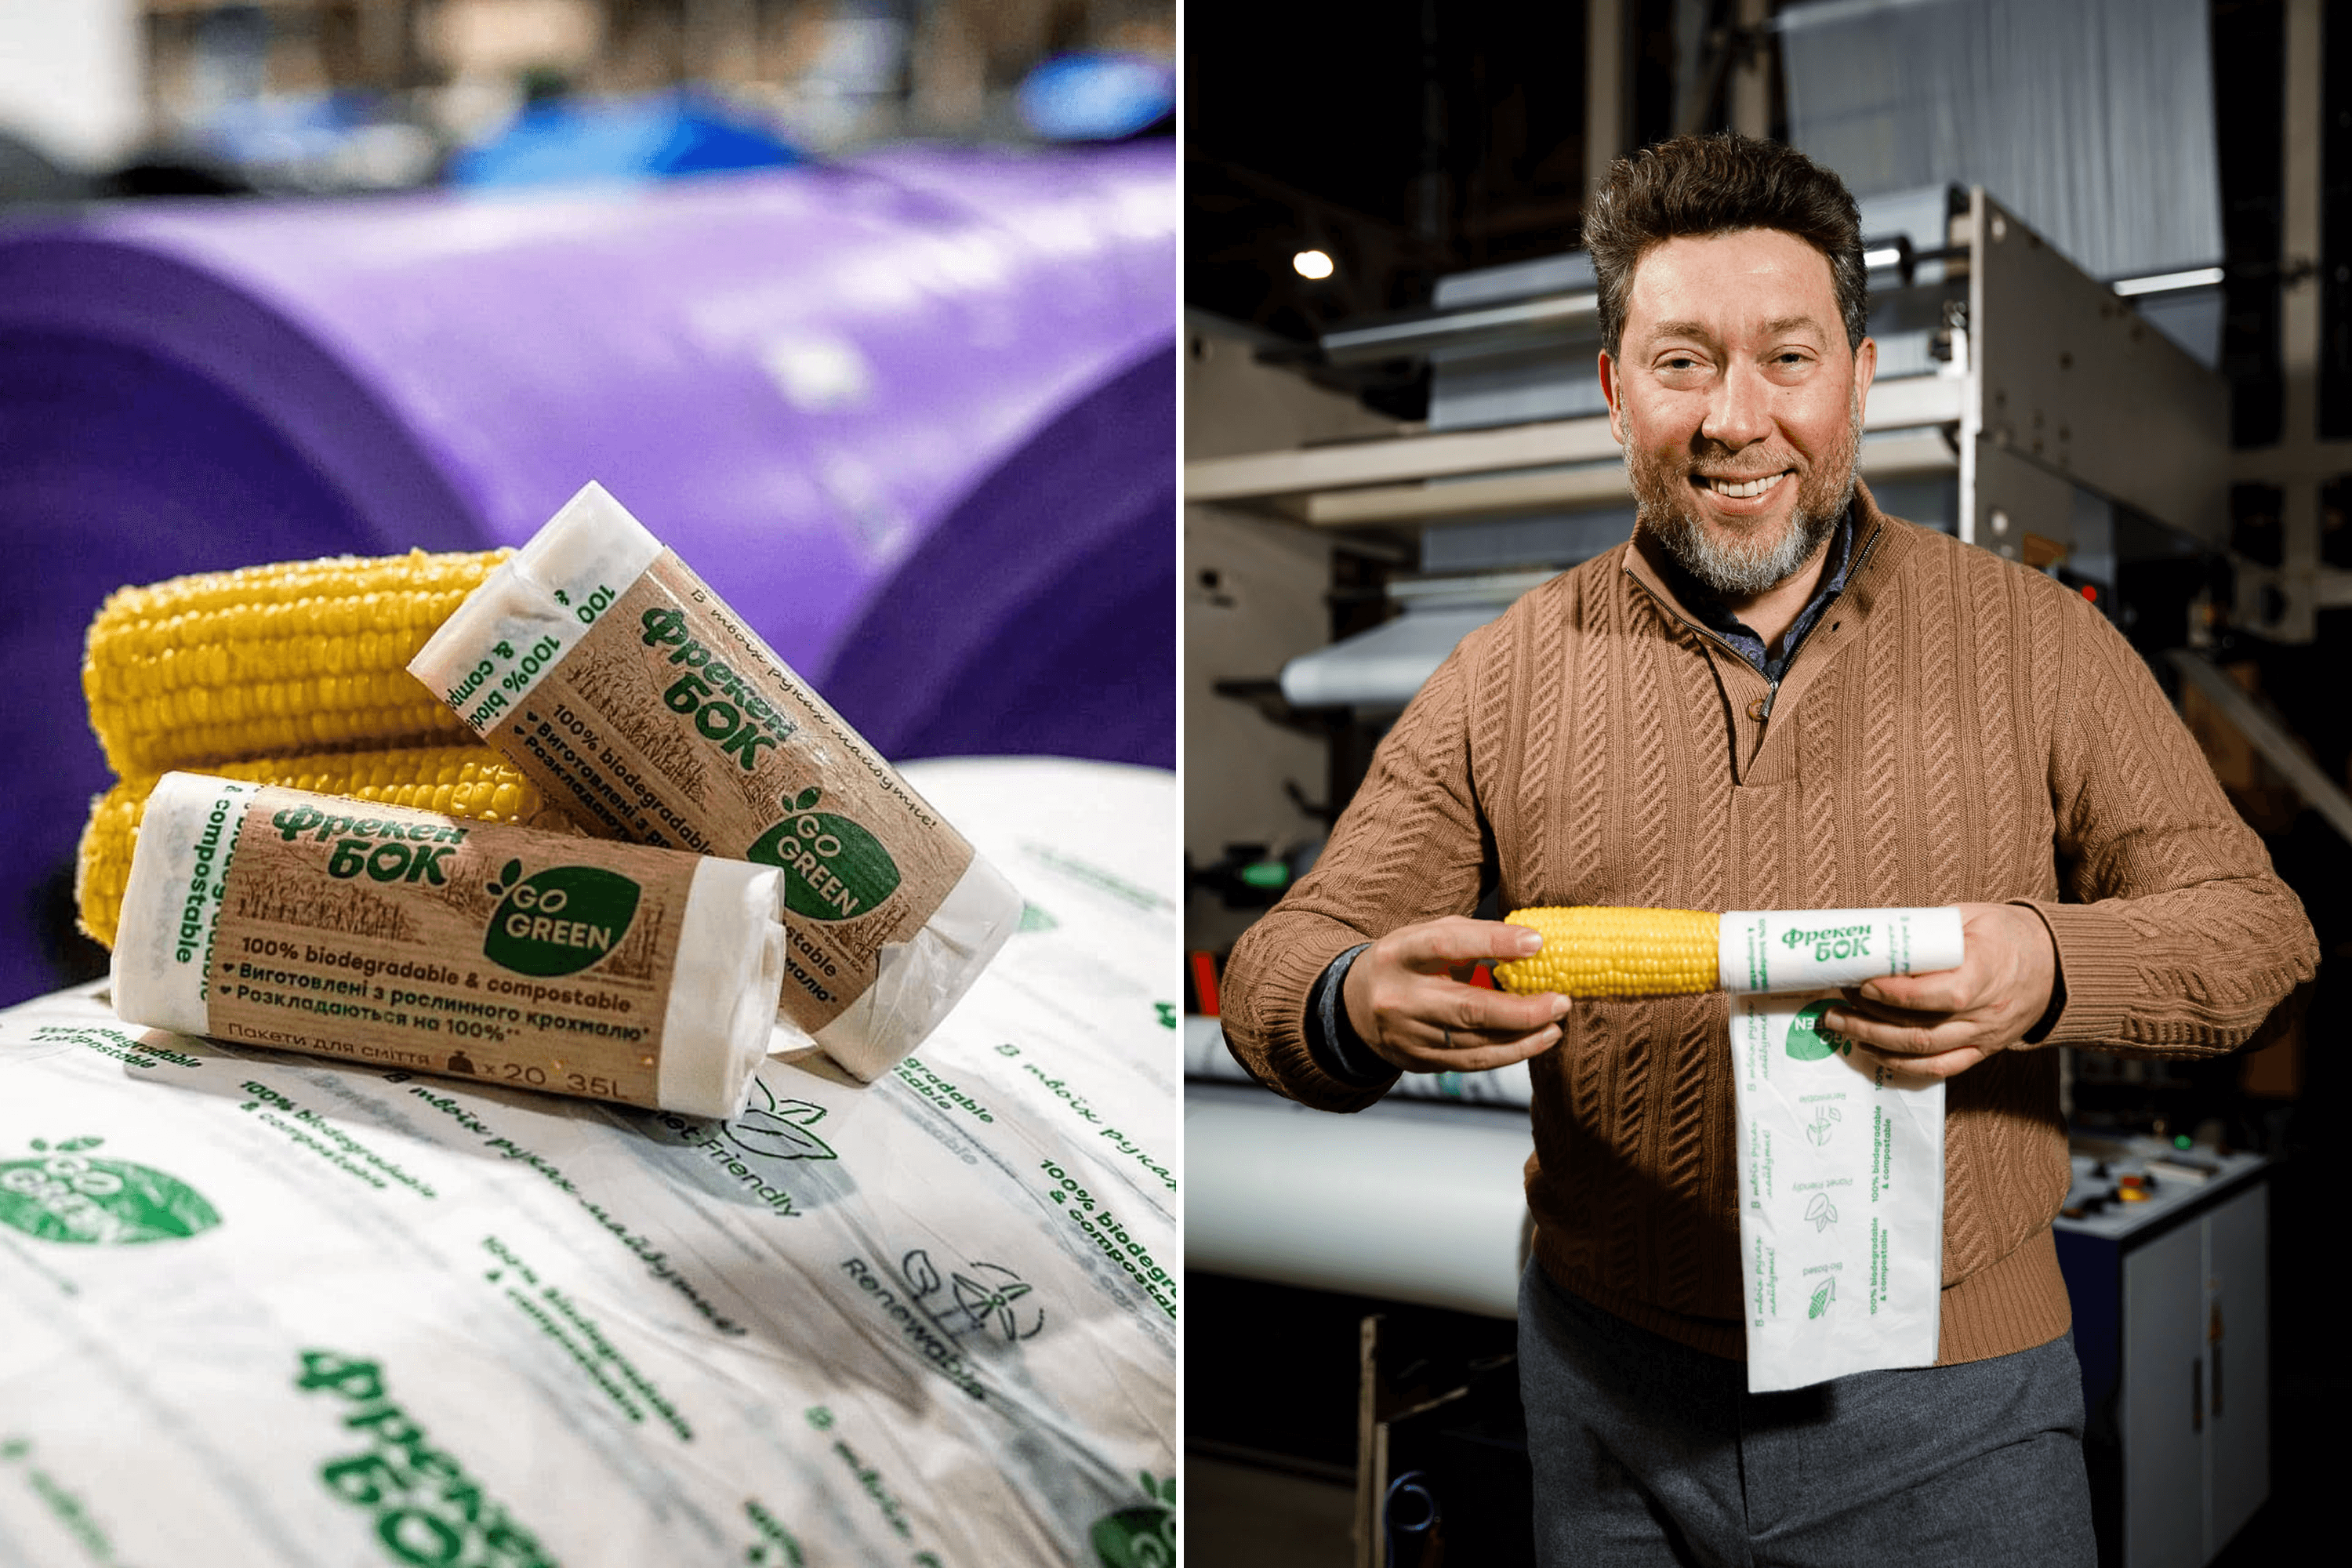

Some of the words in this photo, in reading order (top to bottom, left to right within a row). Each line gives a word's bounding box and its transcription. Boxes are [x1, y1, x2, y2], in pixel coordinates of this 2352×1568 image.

[577, 584, 616, 624] 100
[492, 640, 515, 660] &
[502, 633, 561, 693] 100%
[642, 608, 799, 743] Фрекен
[690, 589, 706, 604] В
[767, 666, 830, 725] руках
[553, 704, 600, 751] 100%
[664, 671, 778, 771] БОК
[537, 720, 641, 819] Виготовлені
[636, 817, 648, 831] з
[273, 803, 470, 845] Фрекен
[795, 814, 842, 858] GO
[175, 798, 231, 964] compostable
[328, 838, 458, 886] БОК
[777, 835, 860, 917] GREEN
[512, 884, 568, 913] GO
[506, 912, 612, 953] GREEN
[784, 925, 838, 978] stable
[1780, 924, 1871, 949] Фрекен
[1814, 936, 1871, 963] БОК
[239, 961, 368, 998] Виготовлені
[373, 985, 385, 1001] з
[390, 989, 521, 1020] рослинного
[242, 936, 299, 960] 100%
[305, 945, 459, 986] biodegradable
[464, 972, 479, 989] &
[486, 978, 633, 1014] compostable
[236, 984, 408, 1027] Розкладаються
[413, 1014, 441, 1032] на
[227, 1022, 307, 1047] Пакети
[313, 1037, 355, 1054] для
[361, 1044, 431, 1067] сміття
[503, 1062, 547, 1086] 20
[567, 1073, 628, 1098] 35L
[902, 1057, 994, 1123] gradable
[1871, 1104, 1882, 1174] biodegradable
[1882, 1117, 1893, 1181] compostable
[696, 1138, 802, 1217] Friendly
[1040, 1159, 1096, 1212] 100%
[1871, 1175, 1880, 1203] 100%
[1869, 1216, 1880, 1287] biodegradable
[1880, 1229, 1889, 1292] compostable
[840, 1256, 986, 1402] Renewable
[1869, 1288, 1878, 1316] 100%
